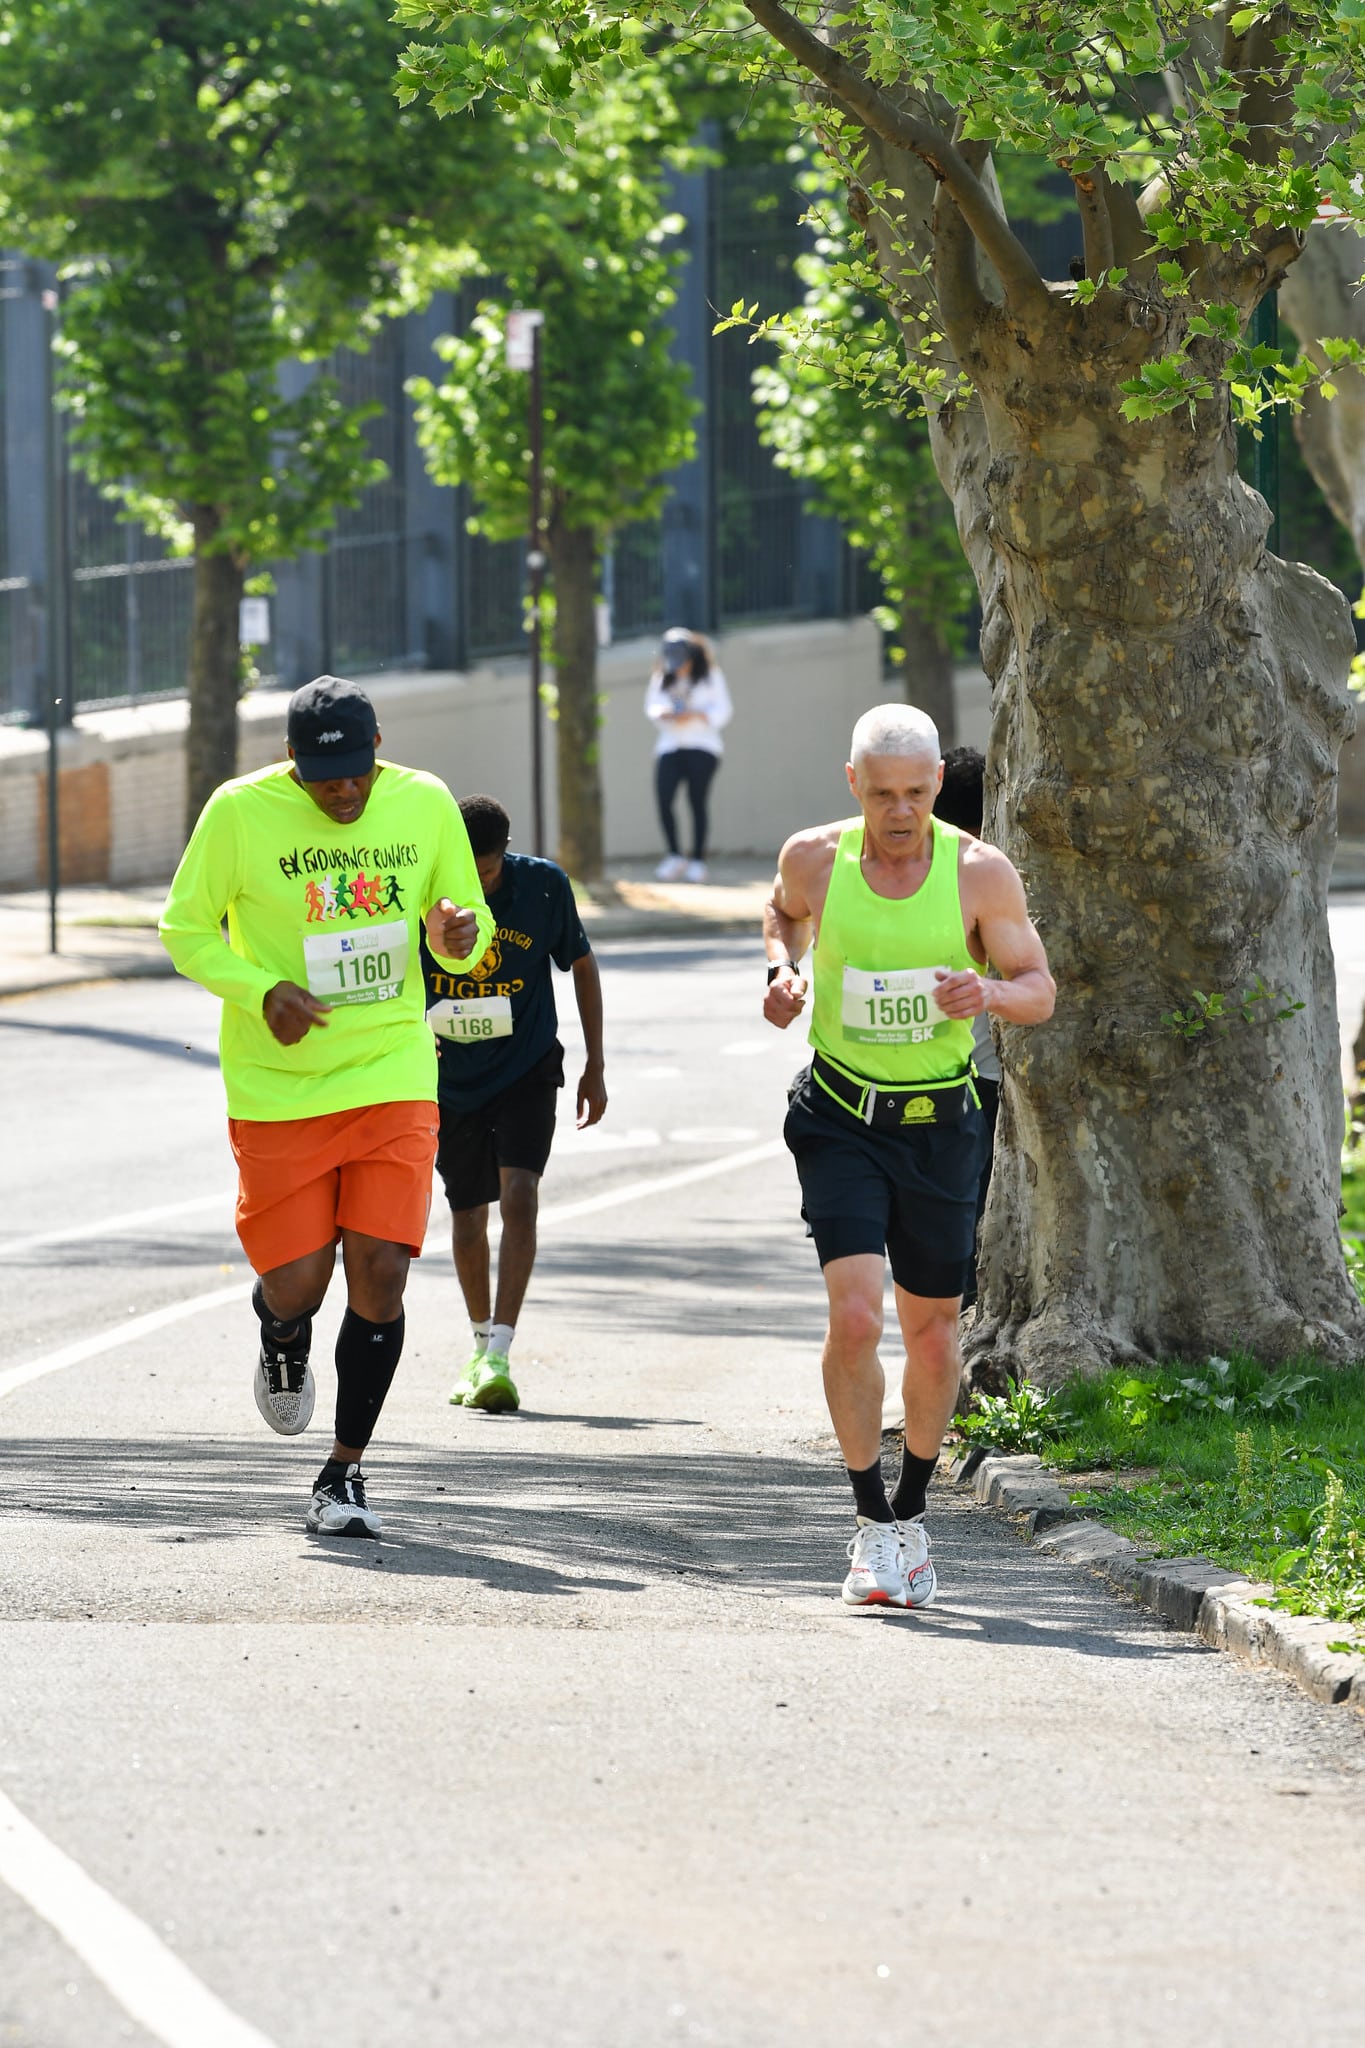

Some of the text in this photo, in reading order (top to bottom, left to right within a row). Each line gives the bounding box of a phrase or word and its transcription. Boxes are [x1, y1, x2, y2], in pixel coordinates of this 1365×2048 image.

[303, 845, 370, 874] ENDURANCE
[373, 843, 418, 870] RUNNERS
[334, 951, 391, 988] 1160
[378, 983, 399, 1001] 5K
[865, 994, 928, 1026] 1560
[447, 1018, 493, 1035] 1168
[911, 1026, 935, 1043] 5K
